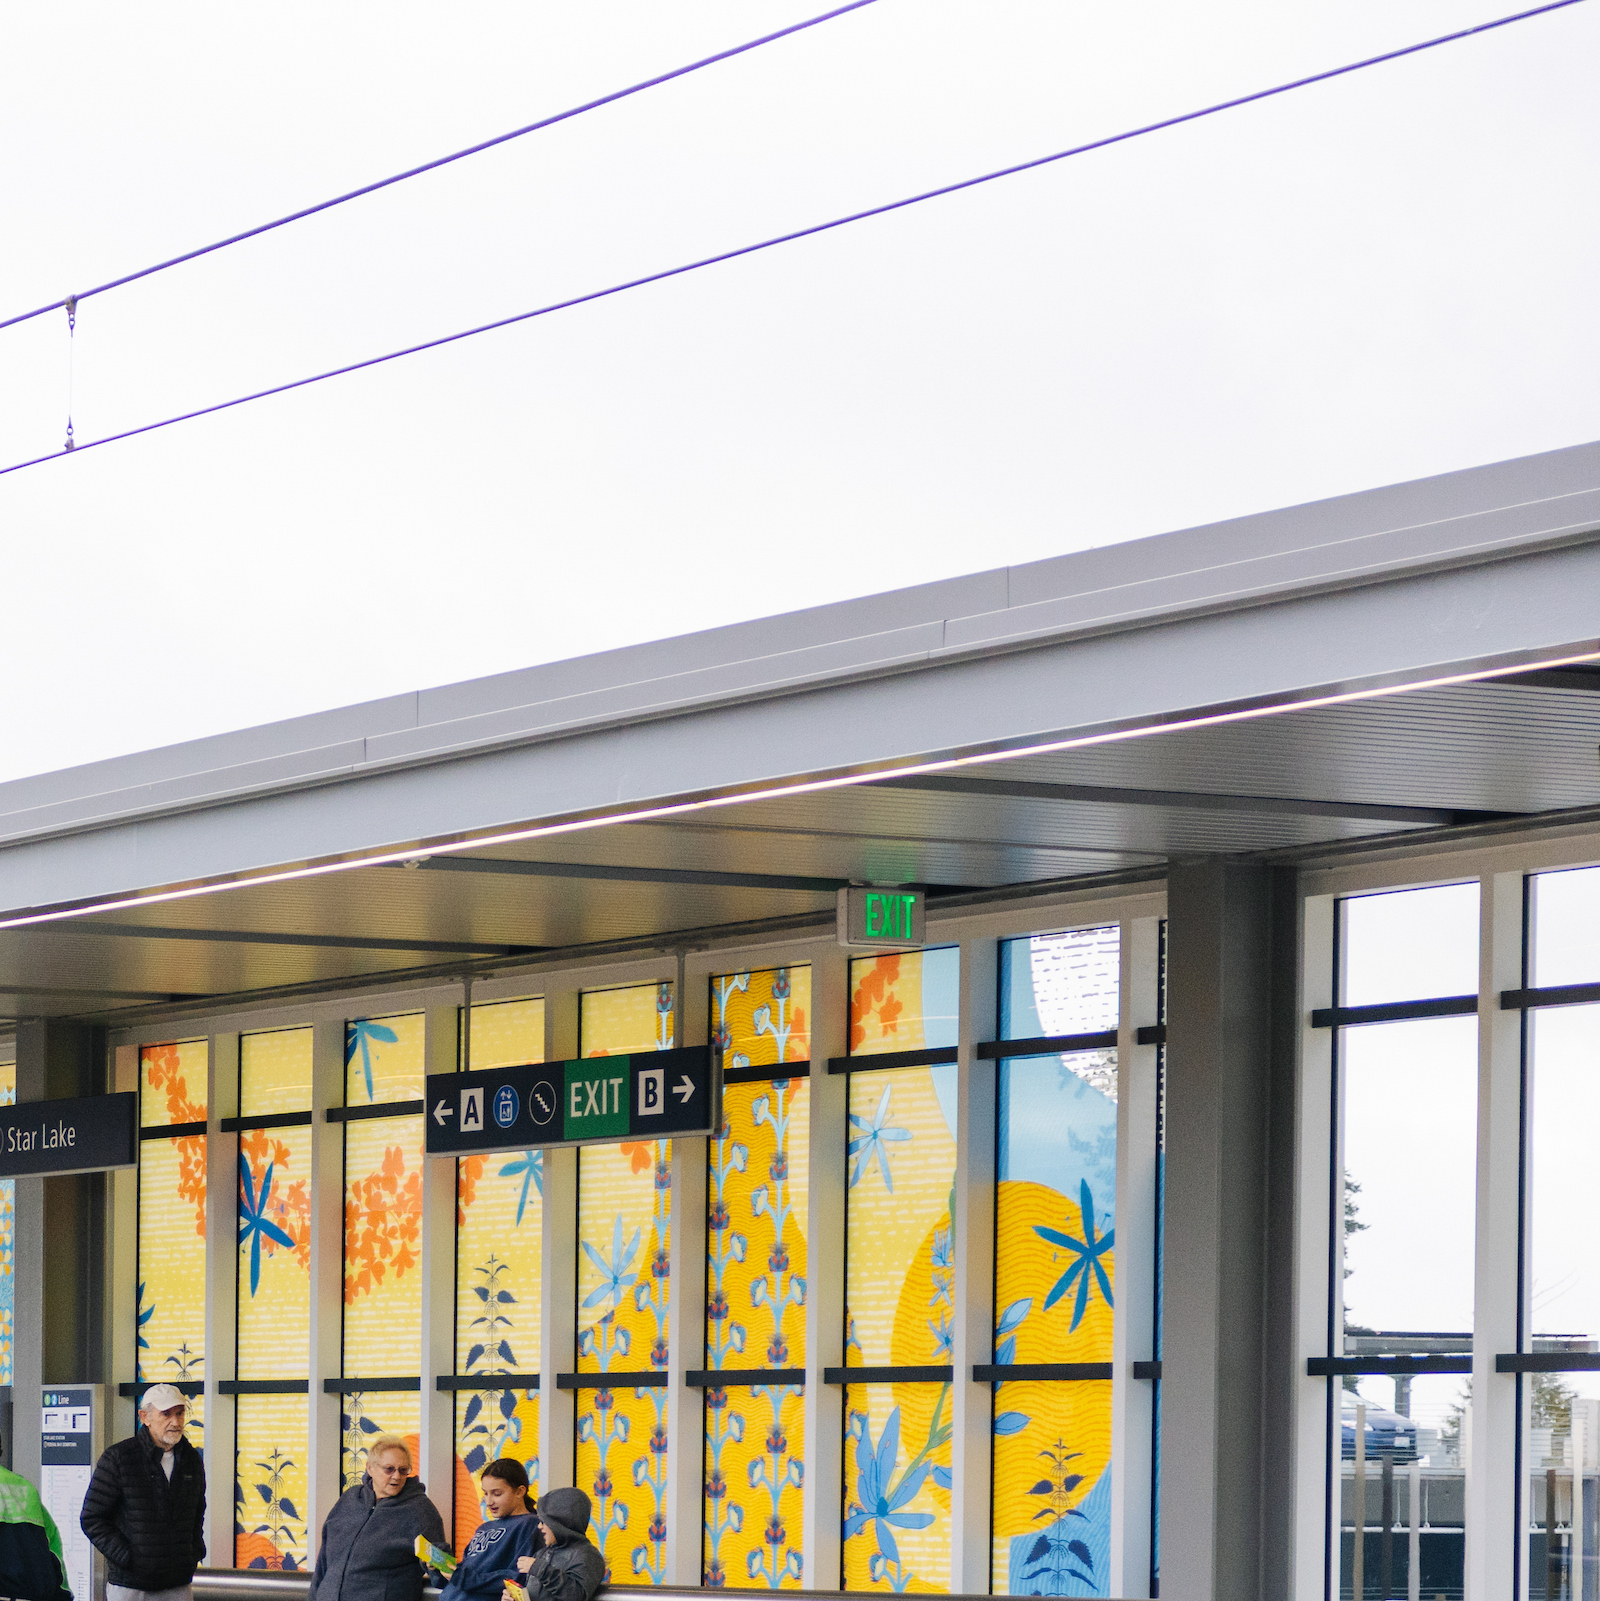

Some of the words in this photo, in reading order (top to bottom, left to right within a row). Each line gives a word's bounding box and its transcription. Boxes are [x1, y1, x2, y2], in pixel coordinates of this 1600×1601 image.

[866, 893, 916, 939] EXIT
[464, 1095, 480, 1125] A
[570, 1077, 623, 1118] EXIT
[644, 1076, 658, 1108] B
[8, 1126, 38, 1152] Star
[42, 1120, 76, 1149] Lake
[58, 1395, 70, 1404] Line
